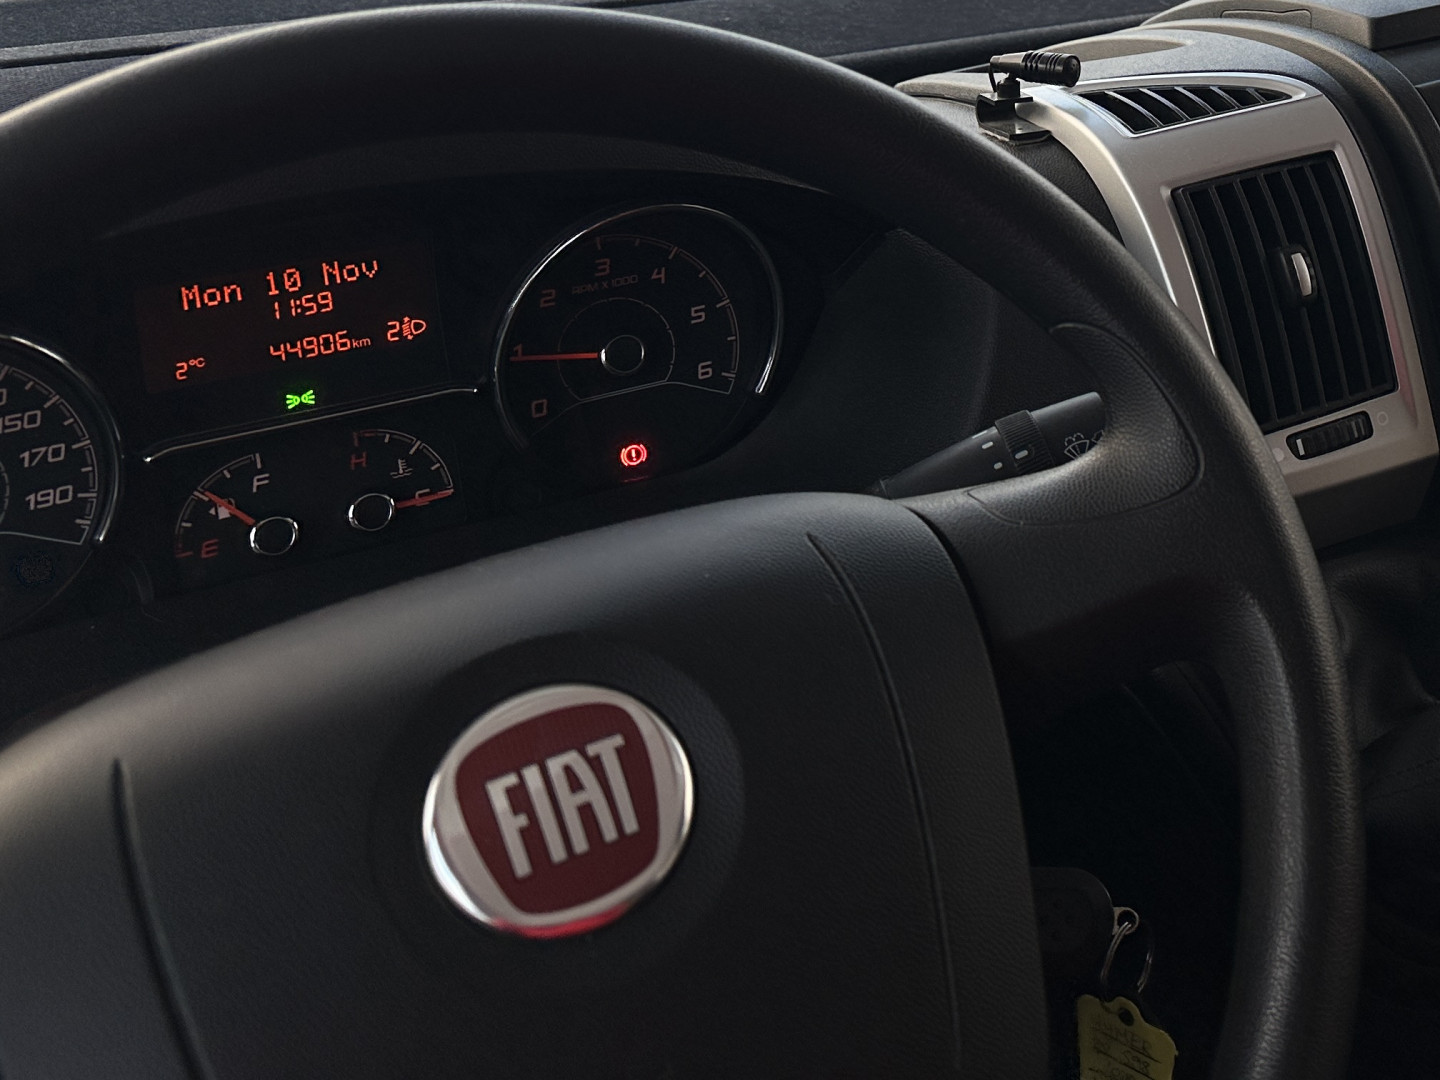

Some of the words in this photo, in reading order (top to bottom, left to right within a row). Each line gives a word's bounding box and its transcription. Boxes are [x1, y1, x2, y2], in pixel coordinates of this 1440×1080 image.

[594, 257, 611, 277] 3
[651, 266, 667, 284] 4
[180, 284, 243, 311] Mon
[266, 268, 301, 296] 10
[322, 260, 378, 286] Nov
[273, 291, 333, 319] 11:59
[540, 288, 557, 309] 2
[690, 305, 706, 324] 5
[698, 361, 713, 380] 6
[0, 409, 42, 434] 50
[19, 442, 66, 468] 170
[252, 473, 270, 493] F
[25, 484, 73, 511] 190
[201, 539, 219, 558] E
[484, 732, 640, 880] FIAT
